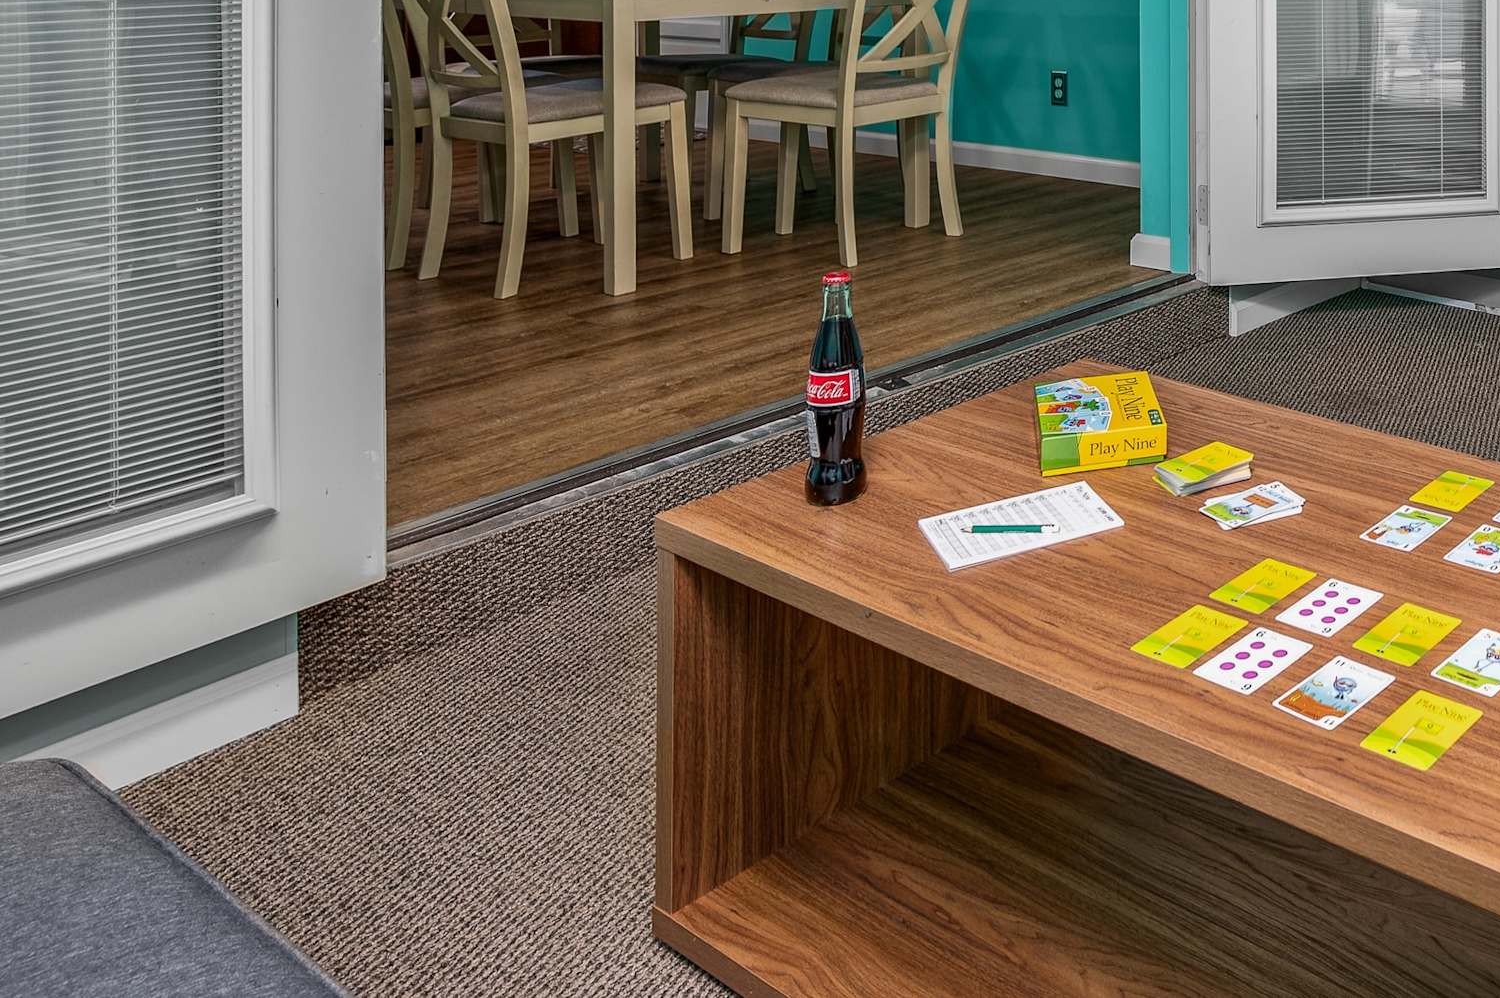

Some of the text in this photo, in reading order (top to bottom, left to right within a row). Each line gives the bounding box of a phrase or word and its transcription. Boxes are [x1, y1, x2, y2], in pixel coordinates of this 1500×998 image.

[1111, 377, 1139, 398] Play
[1121, 396, 1145, 421] Nine
[1089, 437, 1157, 458] Play Nine
[1415, 698, 1468, 722] Play Nine
